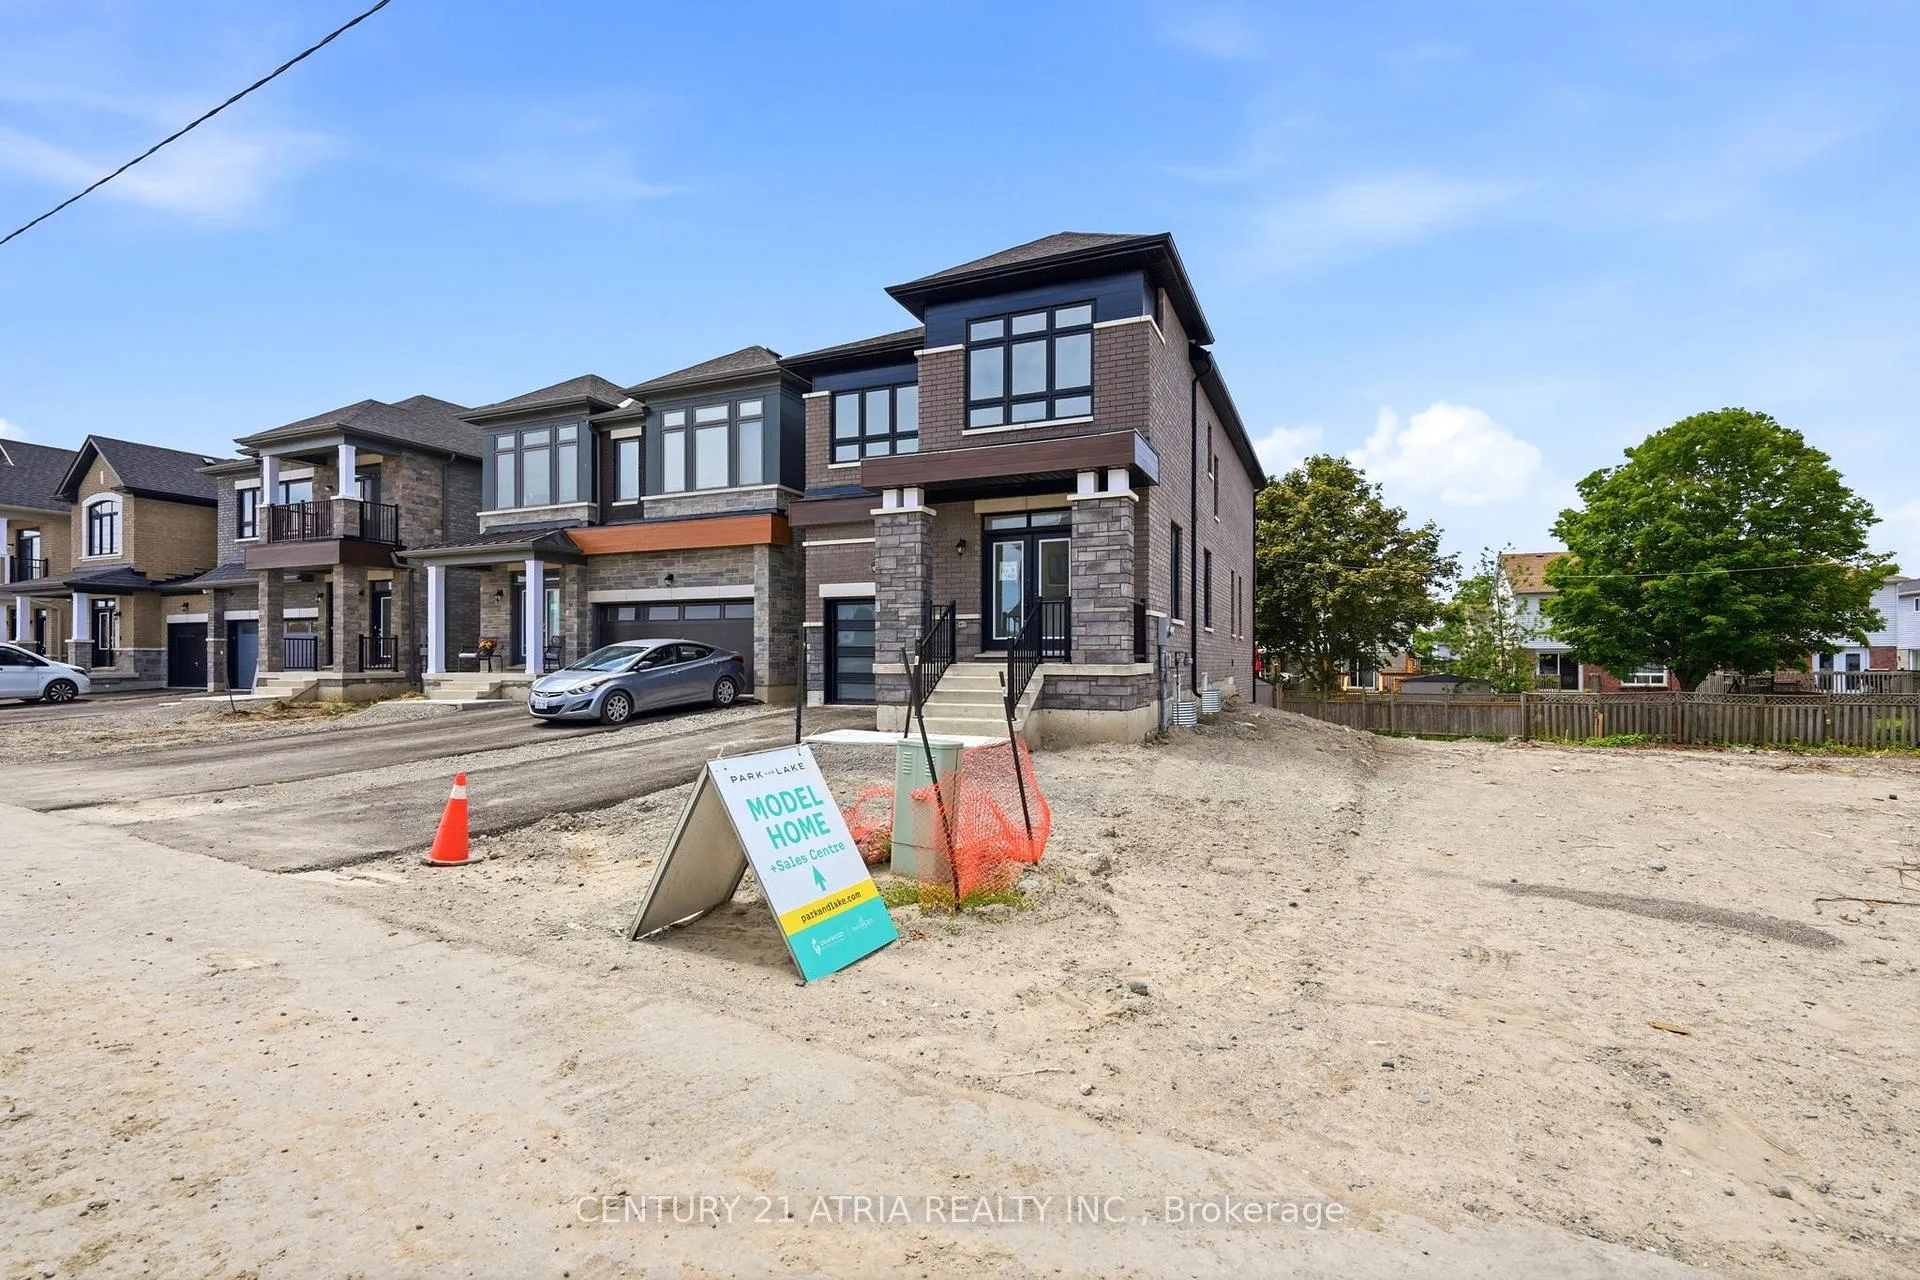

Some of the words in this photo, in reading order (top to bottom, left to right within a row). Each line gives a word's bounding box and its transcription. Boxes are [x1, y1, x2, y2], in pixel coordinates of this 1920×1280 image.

[730, 771, 763, 783] PARK
[775, 762, 805, 775] LAKE
[746, 785, 824, 822] MODEL
[766, 811, 831, 849] HOME
[770, 854, 808, 874] +Sales
[809, 841, 845, 861] Centre
[800, 891, 862, 924] parkandlake.com
